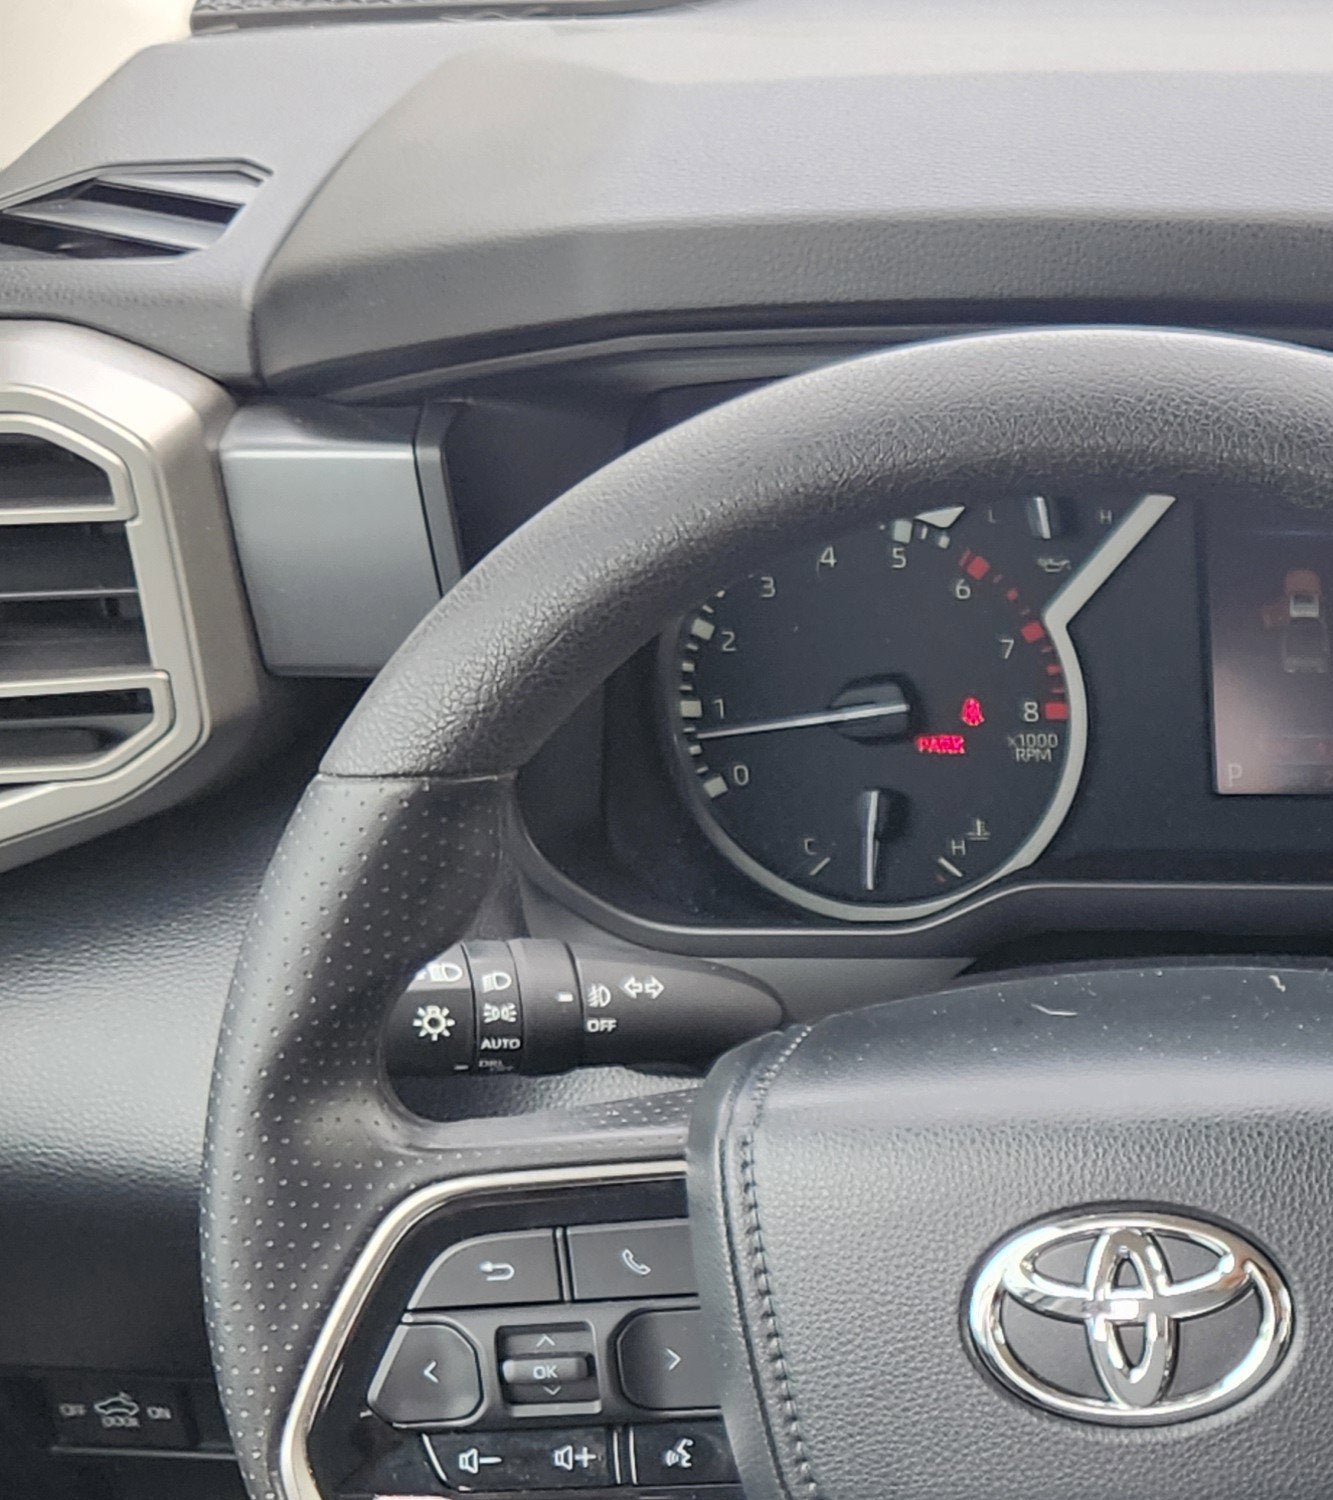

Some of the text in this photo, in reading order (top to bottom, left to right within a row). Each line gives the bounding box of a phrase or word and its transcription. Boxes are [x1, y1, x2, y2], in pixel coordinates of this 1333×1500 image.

[819, 546, 838, 570] 4
[891, 547, 908, 570] 5
[760, 576, 777, 598] 3
[954, 579, 972, 600] 6
[720, 631, 737, 653] 2
[999, 639, 1016, 660] 7
[713, 698, 725, 720] 1
[1023, 700, 1040, 722] 8
[1014, 747, 1054, 763] RPM
[733, 764, 750, 786] 0
[1227, 763, 1243, 788] P
[803, 837, 816, 854] C
[951, 840, 966, 856] H
[585, 1018, 619, 1032] OFF
[480, 1037, 521, 1051] AUTO
[532, 1364, 559, 1380] OK
